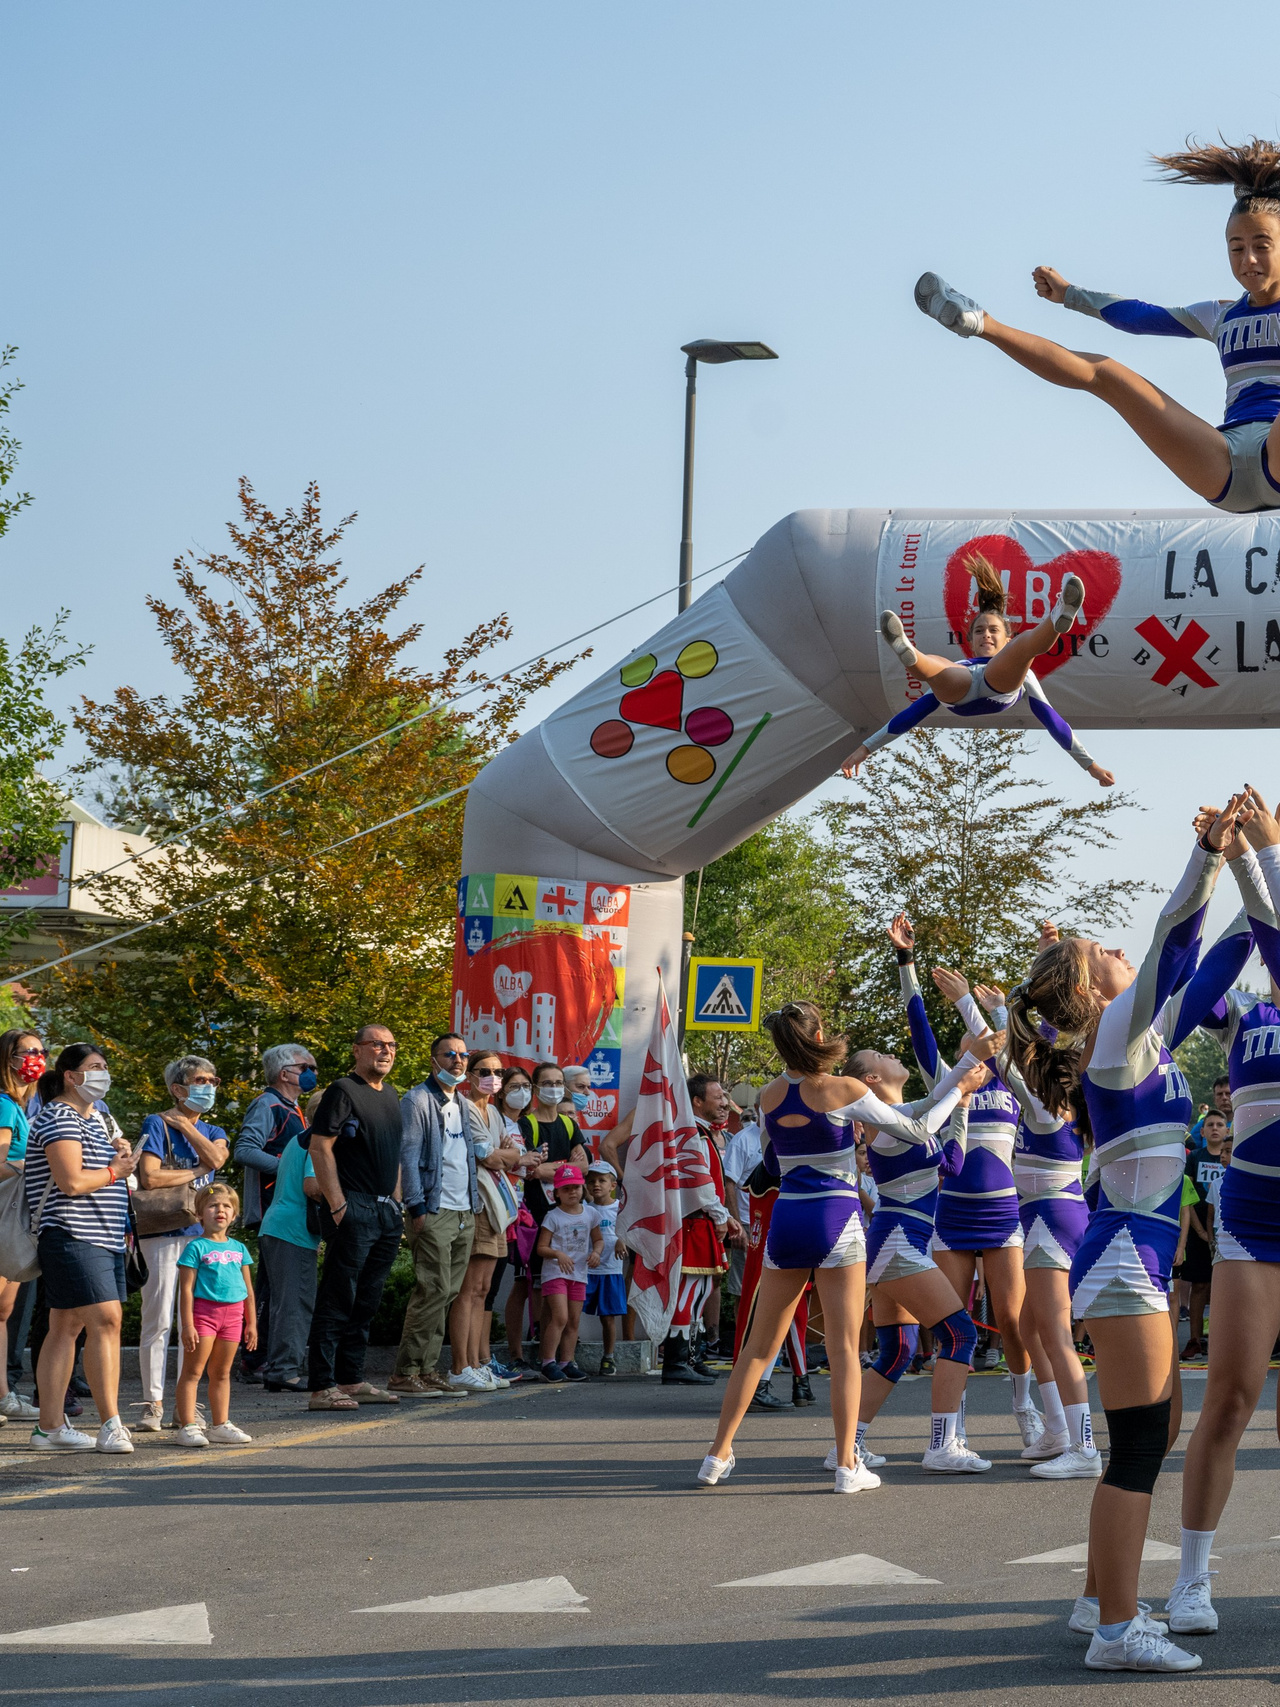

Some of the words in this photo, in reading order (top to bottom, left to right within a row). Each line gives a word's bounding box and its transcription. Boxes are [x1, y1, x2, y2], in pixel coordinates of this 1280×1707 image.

[900, 533, 921, 569] torri
[896, 576, 915, 592] le
[1164, 549, 1219, 600] LA
[900, 600, 917, 650] otto
[597, 895, 619, 907] ALBA
[499, 975, 524, 991] ALBA
[586, 1100, 609, 1111] ALBA
[969, 1090, 1014, 1114] TANS
[932, 1417, 943, 1449] TITANS
